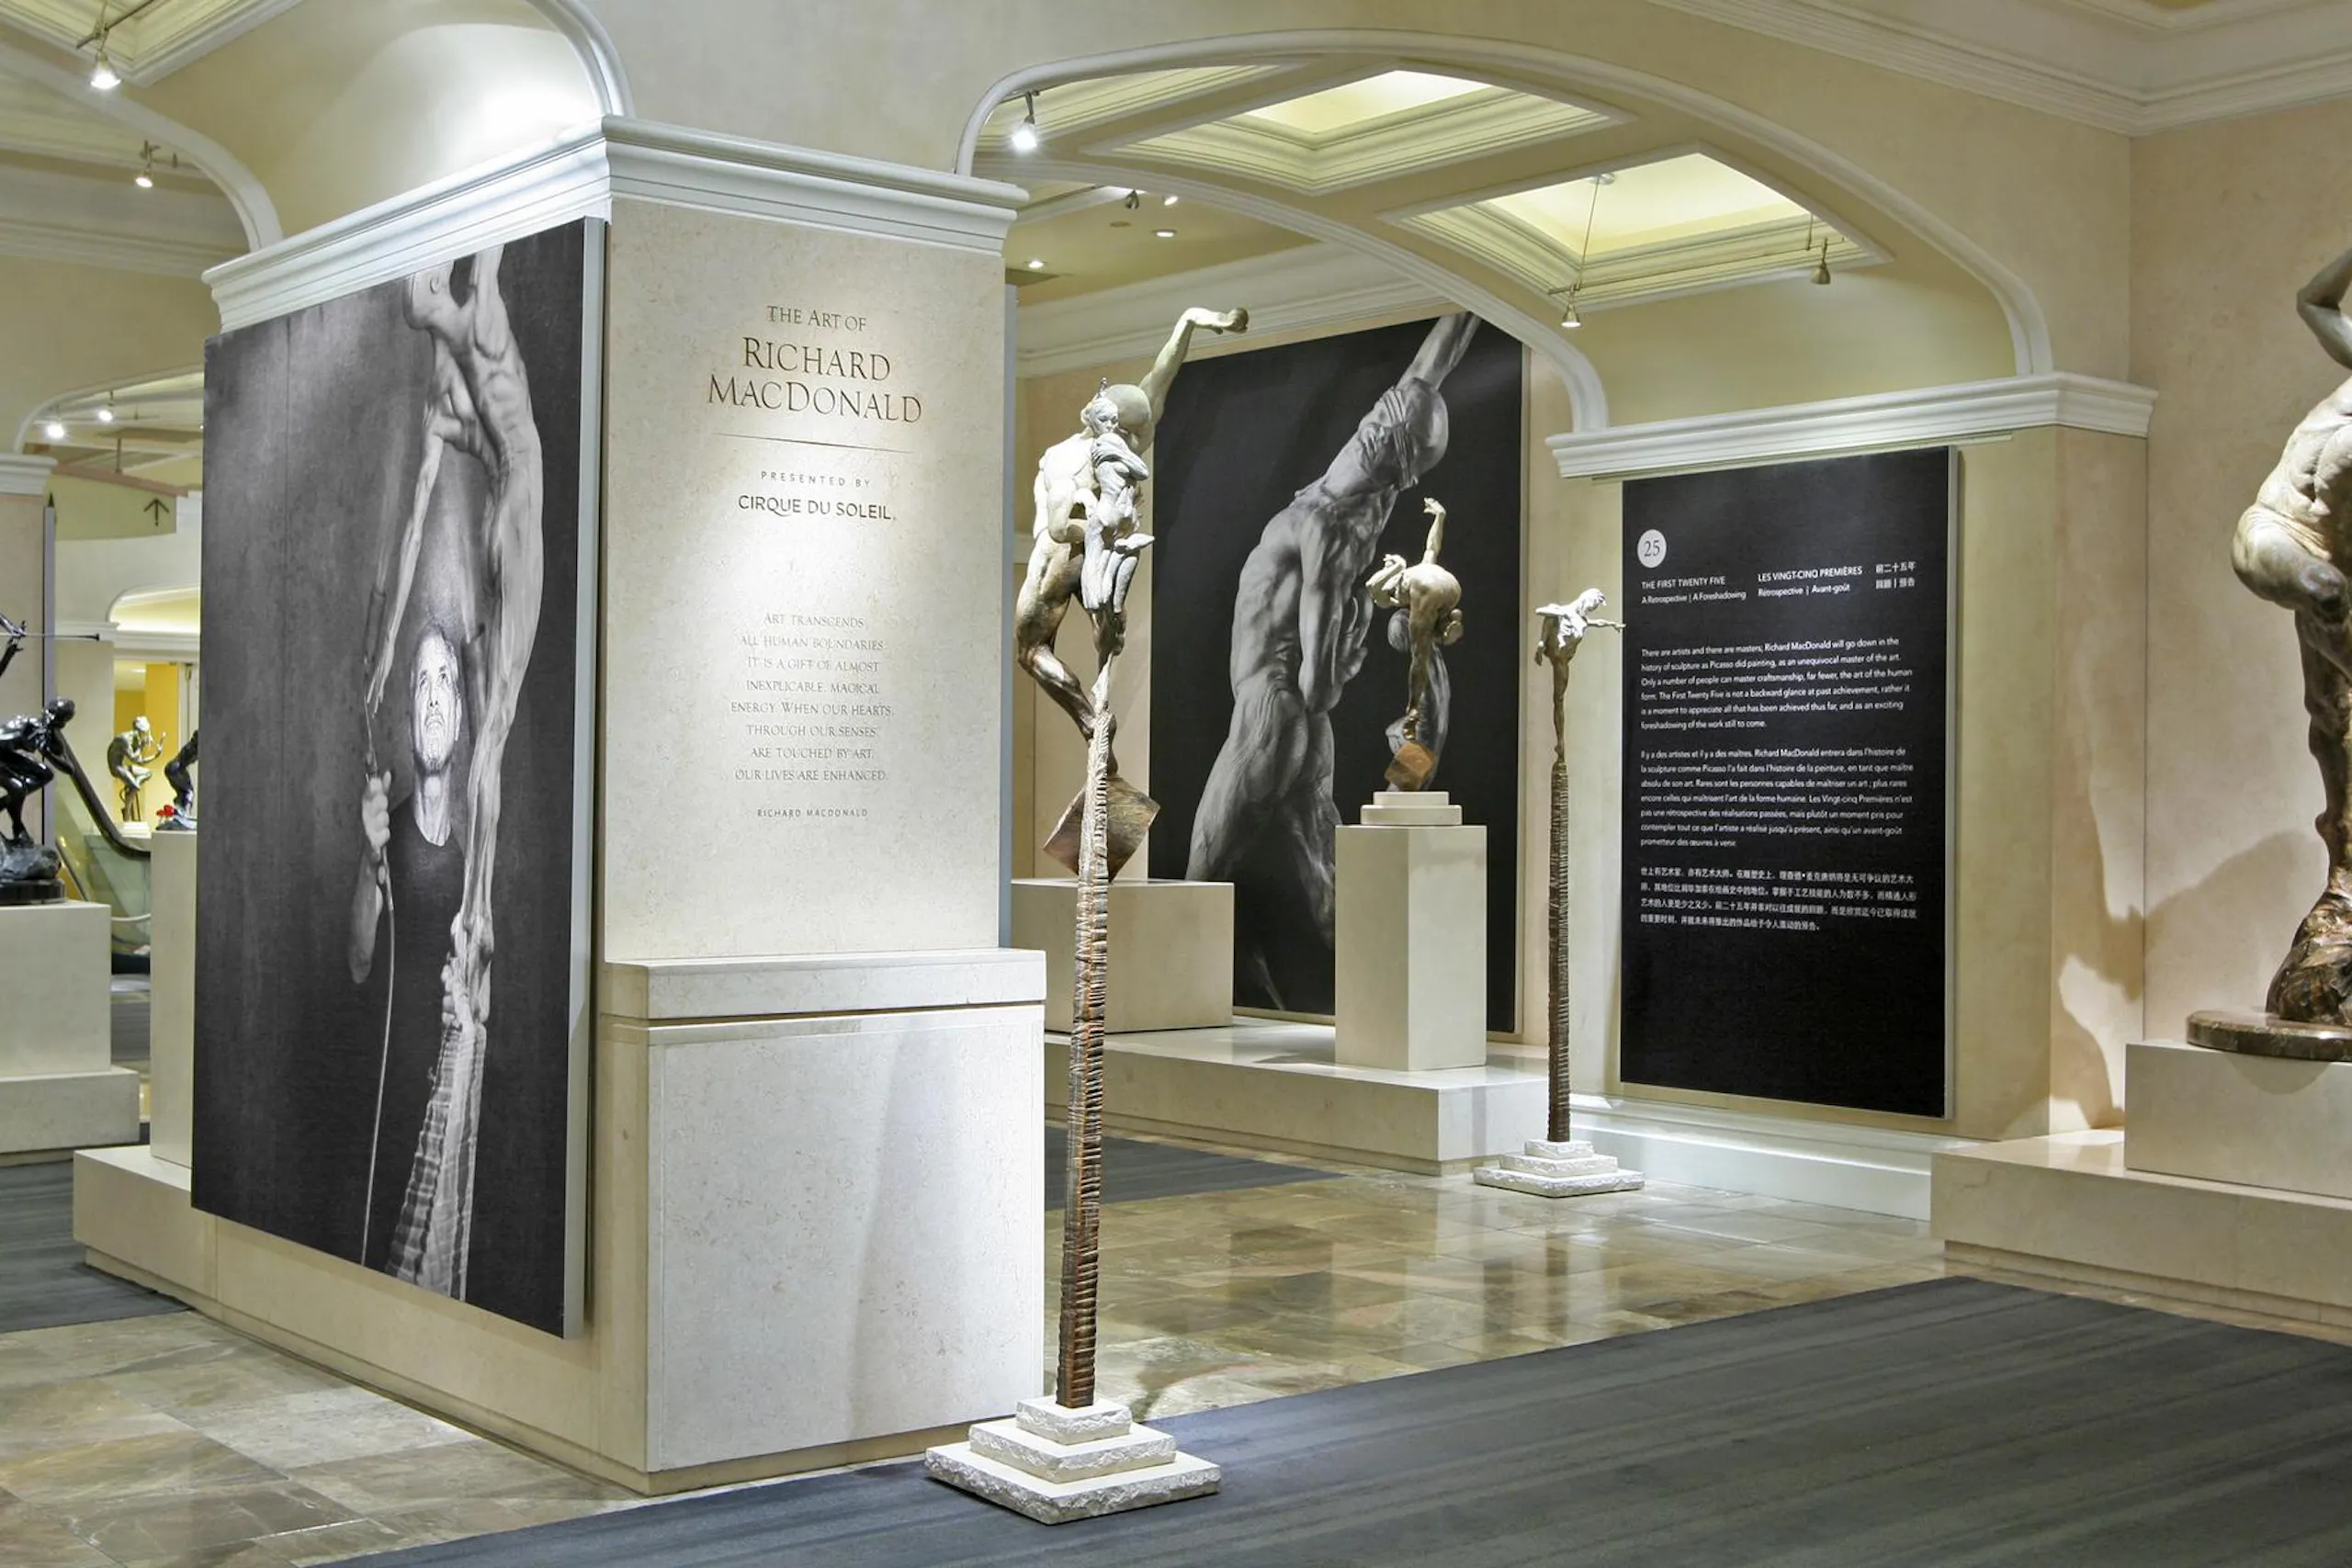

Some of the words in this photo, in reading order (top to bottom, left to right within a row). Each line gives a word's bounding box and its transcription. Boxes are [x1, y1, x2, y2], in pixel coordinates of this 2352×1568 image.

[767, 306, 802, 325] THE
[808, 310, 842, 329] ART
[845, 315, 866, 332] OF
[742, 338, 890, 382] RICHARD
[761, 471, 846, 487] PRESENTED
[855, 479, 870, 489] BY
[739, 495, 800, 516] CIRQUE
[808, 501, 830, 514] DU
[1644, 540, 1660, 557] 25
[1758, 572, 1771, 582] LES
[1820, 565, 1862, 578] PREMIÈRES
[1642, 581, 1655, 590] THE
[1657, 579, 1676, 589] FIRST
[1678, 577, 1708, 588] TWENTY
[1710, 576, 1725, 585] FIVE
[1642, 595, 1647, 604] A
[1647, 594, 1688, 604] Retrospective
[1699, 591, 1747, 602] Foreshadowing
[1758, 586, 1804, 598] Rétrospective
[763, 614, 785, 625] ART
[791, 615, 865, 627] TRANSCENDS
[741, 636, 759, 647] ALL
[763, 637, 808, 648] HUMAN
[1642, 649, 1659, 657] There
[1705, 646, 1723, 654] there
[1765, 643, 1790, 651] Richard
[1792, 640, 1831, 649] MacDonald
[1845, 641, 1855, 649] go
[1857, 638, 1877, 647] down
[1886, 637, 1899, 646] the
[747, 658, 758, 668] IT
[764, 659, 773, 669] IS
[776, 659, 785, 669] A
[787, 659, 813, 670] GIFT
[817, 660, 831, 670] OF
[835, 660, 879, 671] ALMOST
[1641, 662, 1661, 672] history
[1671, 661, 1700, 671] sculpture
[1710, 660, 1734, 668] Picasso
[1747, 659, 1776, 669] painting,
[1797, 656, 1839, 667] unequivocal
[1875, 654, 1887, 662] the
[1641, 678, 1656, 687] Only
[1662, 677, 1687, 685] number
[1688, 676, 1695, 684] of
[1696, 675, 1719, 685] people
[1817, 671, 1838, 681] fewer,
[1839, 671, 1852, 679] the
[1873, 670, 1885, 678] the
[1887, 669, 1913, 677] human
[831, 682, 879, 694] MAGICAL
[1659, 692, 1670, 700] The
[1688, 691, 1709, 700] Twenty
[1710, 690, 1724, 698] Five
[1750, 688, 1782, 696] backward
[1783, 687, 1806, 697] glance
[1815, 687, 1831, 696] past
[1833, 685, 1880, 695] achievement,
[1881, 684, 1903, 693] rather
[781, 703, 819, 715] WHEN
[822, 704, 847, 715] OUR
[1689, 706, 1723, 716] appreciate
[1733, 705, 1747, 713] that
[1779, 704, 1810, 712] achieved
[1811, 703, 1826, 711] thus
[1874, 702, 1904, 711] exciting
[746, 725, 806, 736] THROUGH
[810, 726, 835, 736] OUR
[1641, 721, 1687, 730] foreshadowing
[1696, 720, 1706, 728] the
[751, 748, 771, 759] ARE
[775, 748, 832, 759] TOUCHED
[837, 749, 849, 759] BY
[1781, 749, 1819, 757] MacDonald
[735, 770, 762, 780] OUR
[765, 770, 795, 780] LIVES
[797, 770, 820, 781] ARE
[823, 770, 889, 781] ENHANCED.
[1823, 795, 1858, 805] Vingt-cinq
[1806, 810, 1827, 819] plutôt
